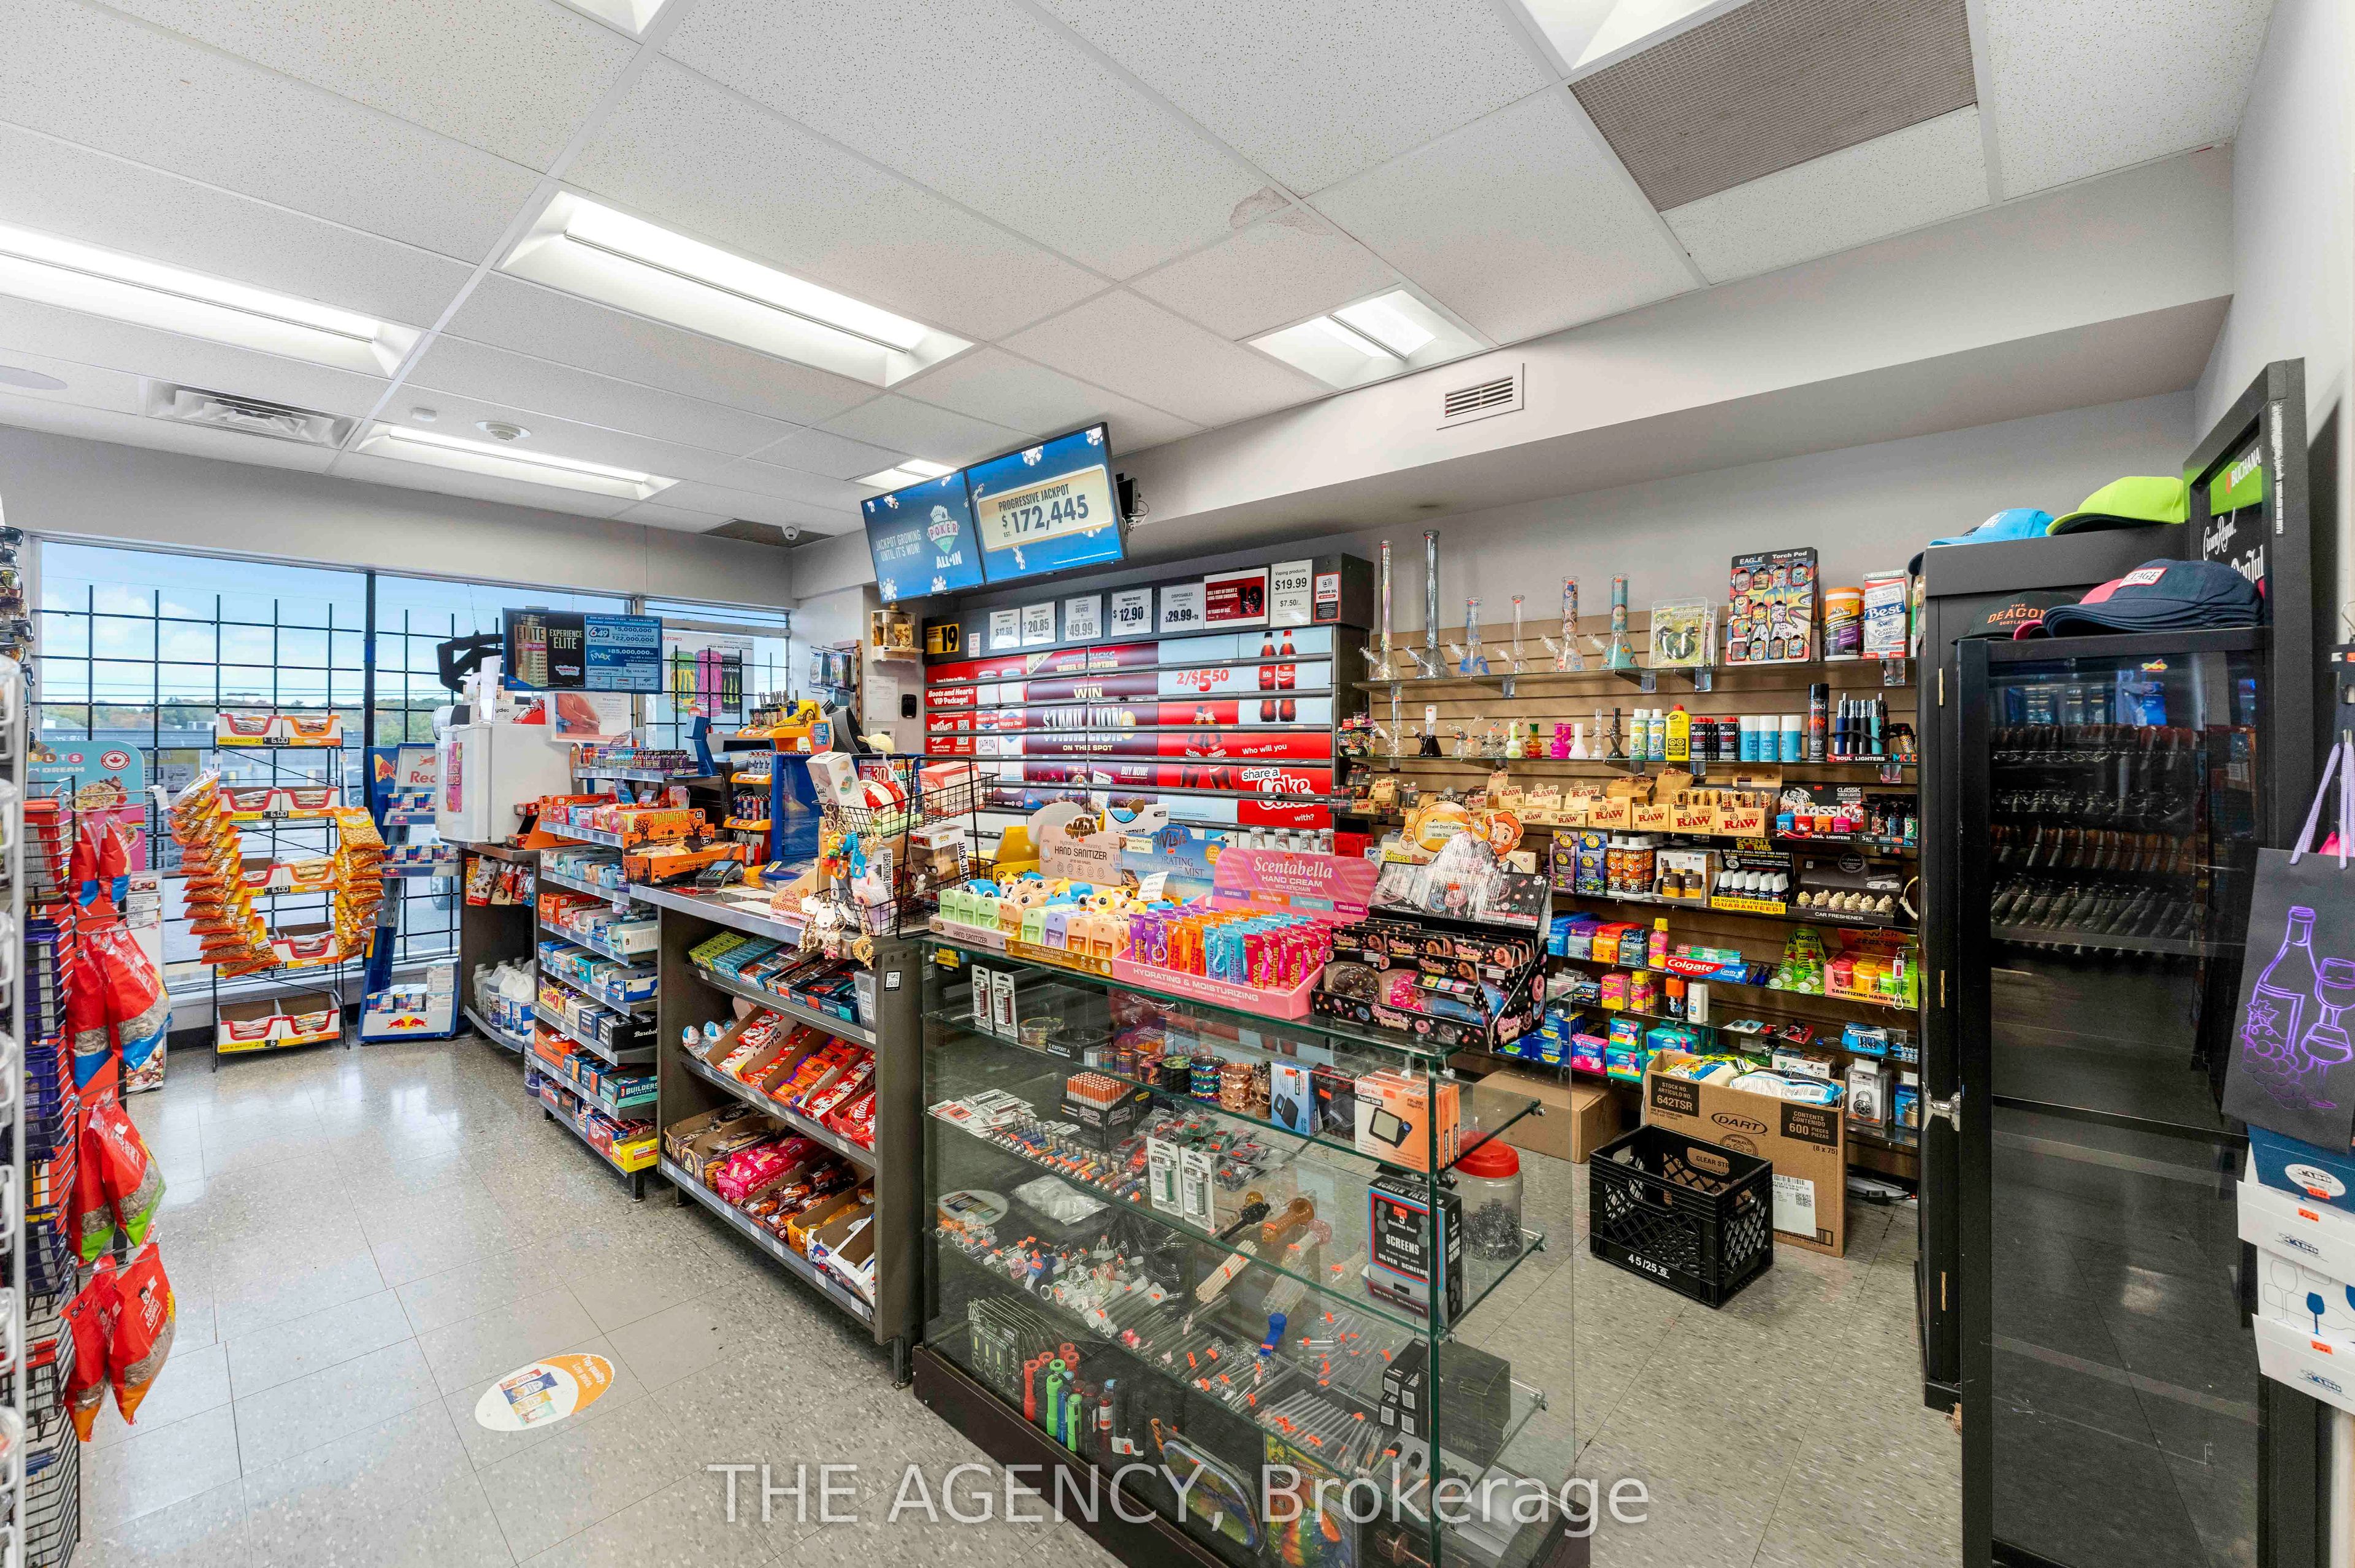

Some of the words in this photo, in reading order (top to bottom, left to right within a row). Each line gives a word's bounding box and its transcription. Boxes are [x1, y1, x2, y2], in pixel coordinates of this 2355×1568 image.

[998, 492, 1040, 511] PROGRESSIVE
[1041, 484, 1070, 502] JACKPOT
[1012, 494, 1089, 533] 172,445
[929, 521, 958, 541] POKER
[876, 534, 896, 551] JACKPOT
[897, 530, 921, 545] GROWING
[880, 546, 895, 561] UNTIL
[1275, 578, 1307, 591] $19.99
[1240, 586, 1263, 614] 19
[1028, 618, 1049, 633] 20.85
[1070, 622, 1093, 637] 49.99
[517, 627, 544, 641] ELITE
[550, 629, 582, 638] EXPERIENCE
[941, 625, 958, 651] 19
[554, 637, 576, 649] ELITE
[1028, 655, 1043, 672] NEW
[1074, 687, 1102, 698] WIN
[944, 696, 968, 705] Package!
[1274, 743, 1287, 752] you
[873, 767, 887, 781] 30
[1121, 766, 1135, 776] BUY
[1136, 767, 1149, 776] NOW!
[1243, 769, 1269, 779] share
[651, 811, 688, 825] HALLOWEEN
[1294, 813, 1314, 822] with?
[1595, 810, 1624, 820] RAW
[1639, 813, 1664, 822] RAW
[1055, 846, 1071, 855] HAND
[1074, 850, 1107, 860] SANITIZER
[1385, 849, 1410, 863] Stress
[957, 841, 970, 884] JACK-JACK
[1254, 857, 1333, 879] Scentabella
[272, 885, 289, 894] 6.00
[1290, 878, 1323, 887] CREAM
[1714, 902, 1782, 912] GUARANTEED!
[953, 930, 964, 939] HAND
[966, 933, 987, 944] SANITIZER
[1019, 943, 1040, 952] HYDRATING
[1041, 947, 1063, 957] FRAGRANCE
[1668, 959, 1714, 971] Colgate
[1133, 968, 1181, 986] HYDRATING
[1184, 978, 1190, 987] &
[1192, 980, 1259, 1002] MOISTURIZING
[1832, 989, 1867, 998] SANITIZING
[1578, 1046, 1596, 1055] always
[1657, 1095, 1693, 1111] 642TSR
[1718, 1115, 1761, 1131] DART
[1793, 1111, 1825, 1122] CONTENTS
[1793, 1116, 1825, 1127] CONTENIDO
[1789, 1123, 1809, 1134] 600
[1388, 1220, 1406, 1230] Stainless
[1386, 1234, 1420, 1255] SCREENS
[1449, 1236, 1460, 1253] SCREEN
[1378, 1253, 1398, 1266] SILVER
[1401, 1262, 1428, 1277] SCREENS
[583, 1356, 592, 1367] Top
